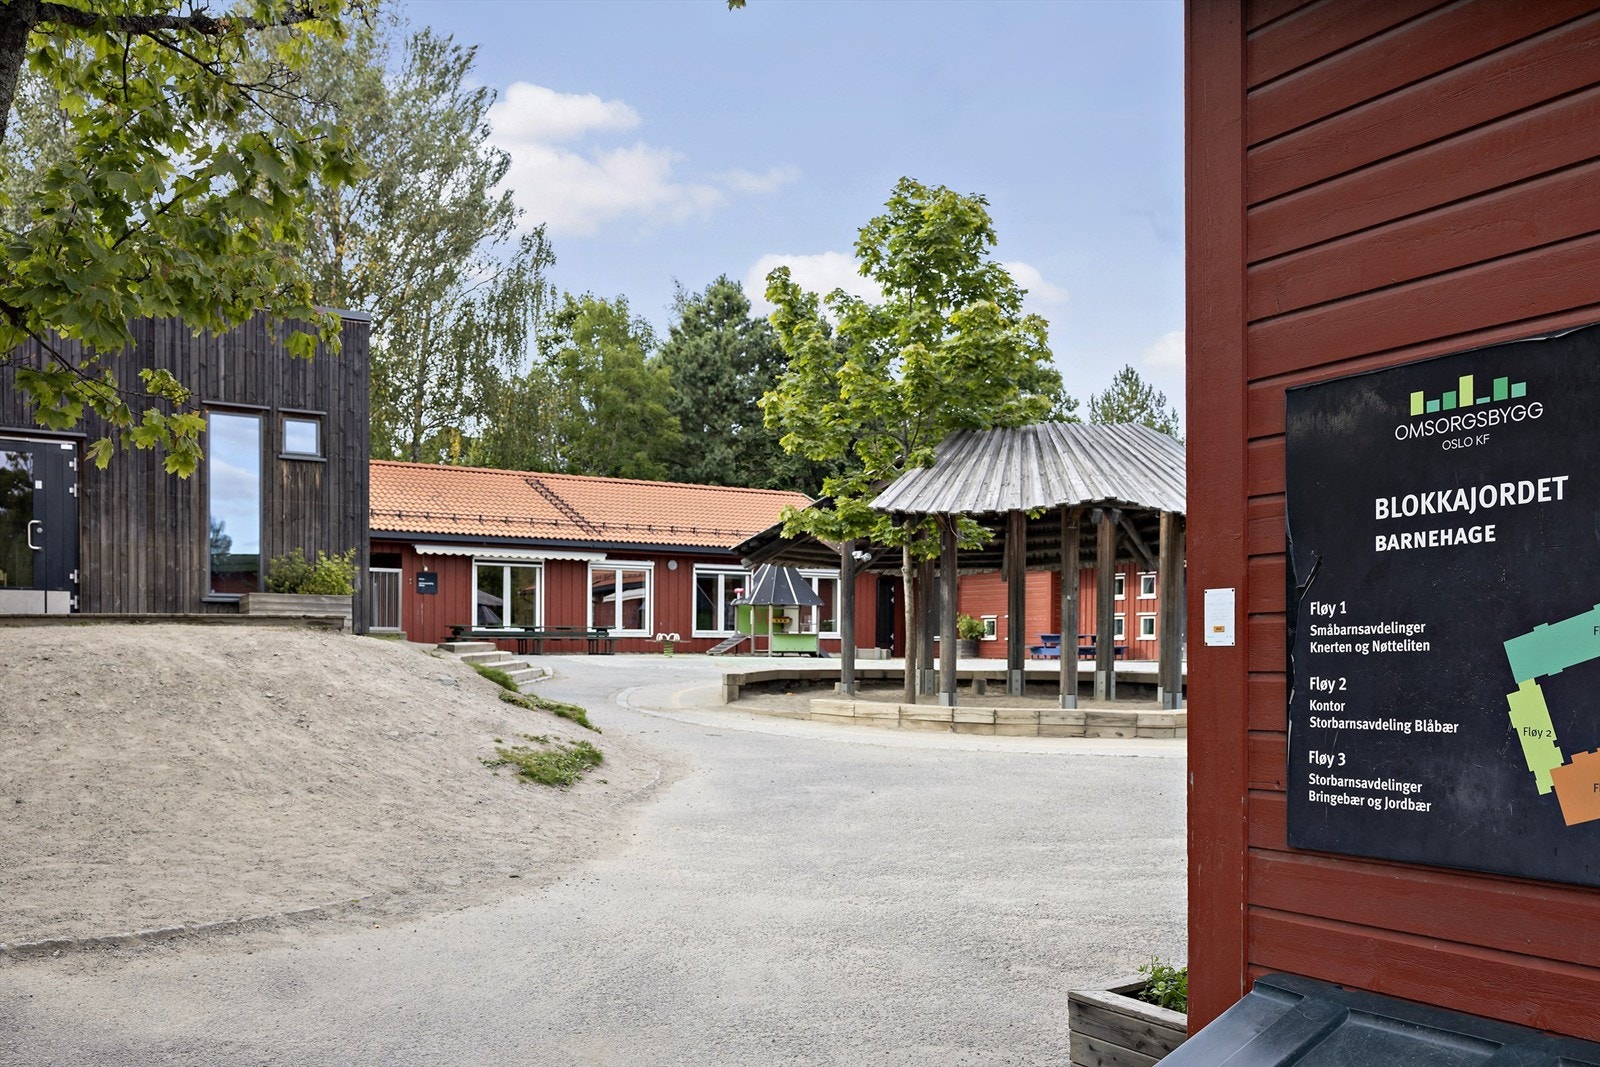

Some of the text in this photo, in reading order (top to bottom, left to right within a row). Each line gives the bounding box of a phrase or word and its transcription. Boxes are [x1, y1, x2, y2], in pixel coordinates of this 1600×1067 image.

[1394, 401, 1544, 441] OMSORGSBYGG
[1441, 433, 1491, 451] OSLO KF
[1375, 475, 1569, 520] BLOKKAJORDET
[1375, 524, 1496, 552] BARNEHAGE
[1310, 600, 1347, 619] Fløy 1
[1310, 621, 1426, 637] Småbarnsavdelinger
[1310, 638, 1431, 655] Knerten og Nøtteliten
[1309, 676, 1347, 694] Fløy 2
[1309, 699, 1346, 712] Kontor
[1309, 716, 1459, 734] Storbarnsavdeling Blåbær
[1523, 727, 1552, 739] Fløy 2
[1308, 750, 1346, 768] Fløy 3
[1308, 773, 1423, 793] Storbarnsavdelinger
[1308, 789, 1432, 812] Bringebær og Jordbær
